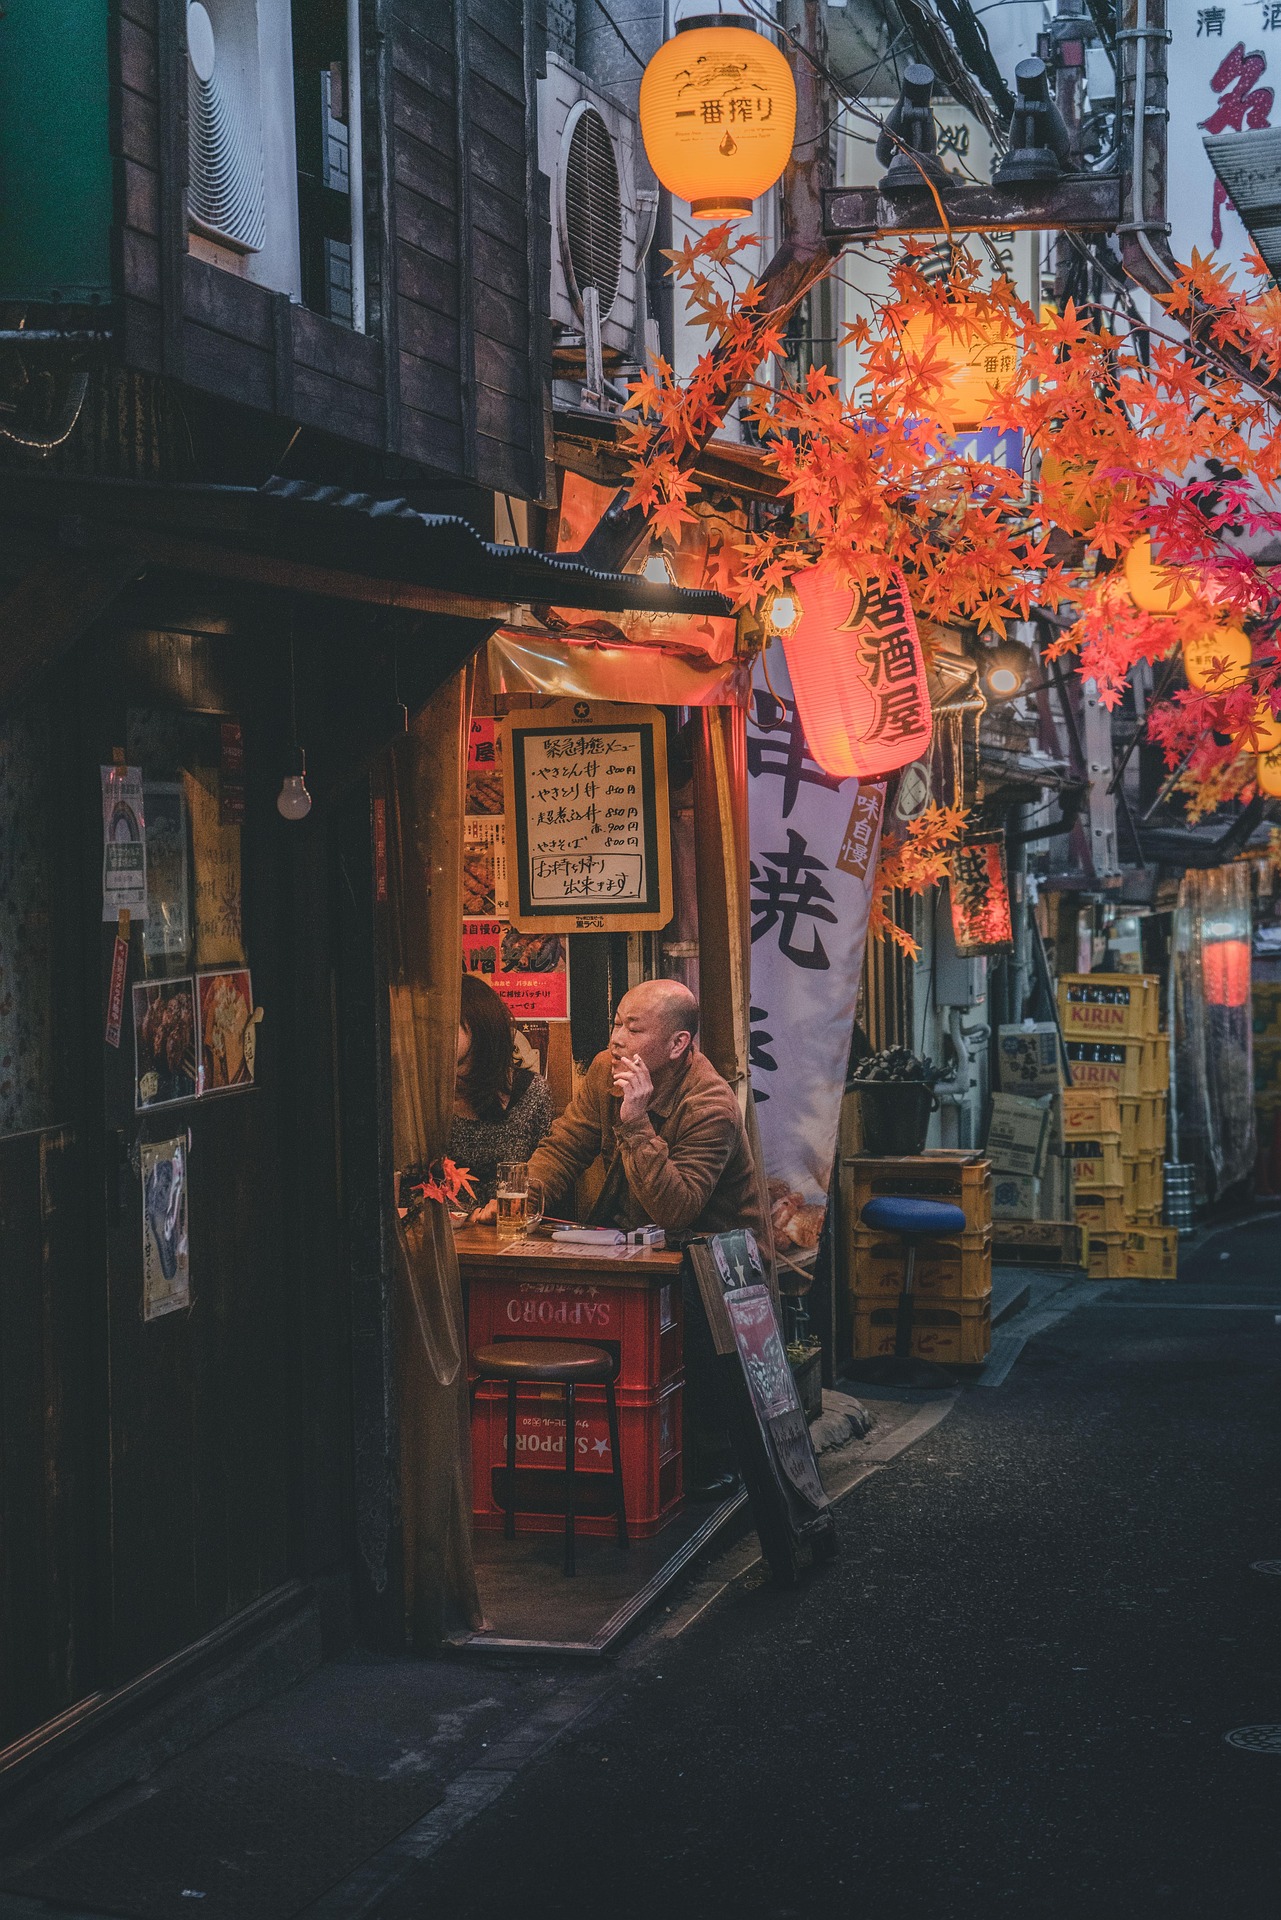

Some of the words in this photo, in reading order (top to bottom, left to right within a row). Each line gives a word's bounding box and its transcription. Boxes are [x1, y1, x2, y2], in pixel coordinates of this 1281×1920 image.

[675, 97, 772, 124] 一番搾り
[842, 572, 926, 743] 居酒屋
[604, 837, 639, 848] 800円
[842, 795, 880, 871] 味自慢
[535, 856, 605, 878] お持ち帰り
[575, 921, 605, 929] 黒ラベル
[1071, 1006, 1124, 1024] KIRIN
[507, 1299, 611, 1326] SAPPORO
